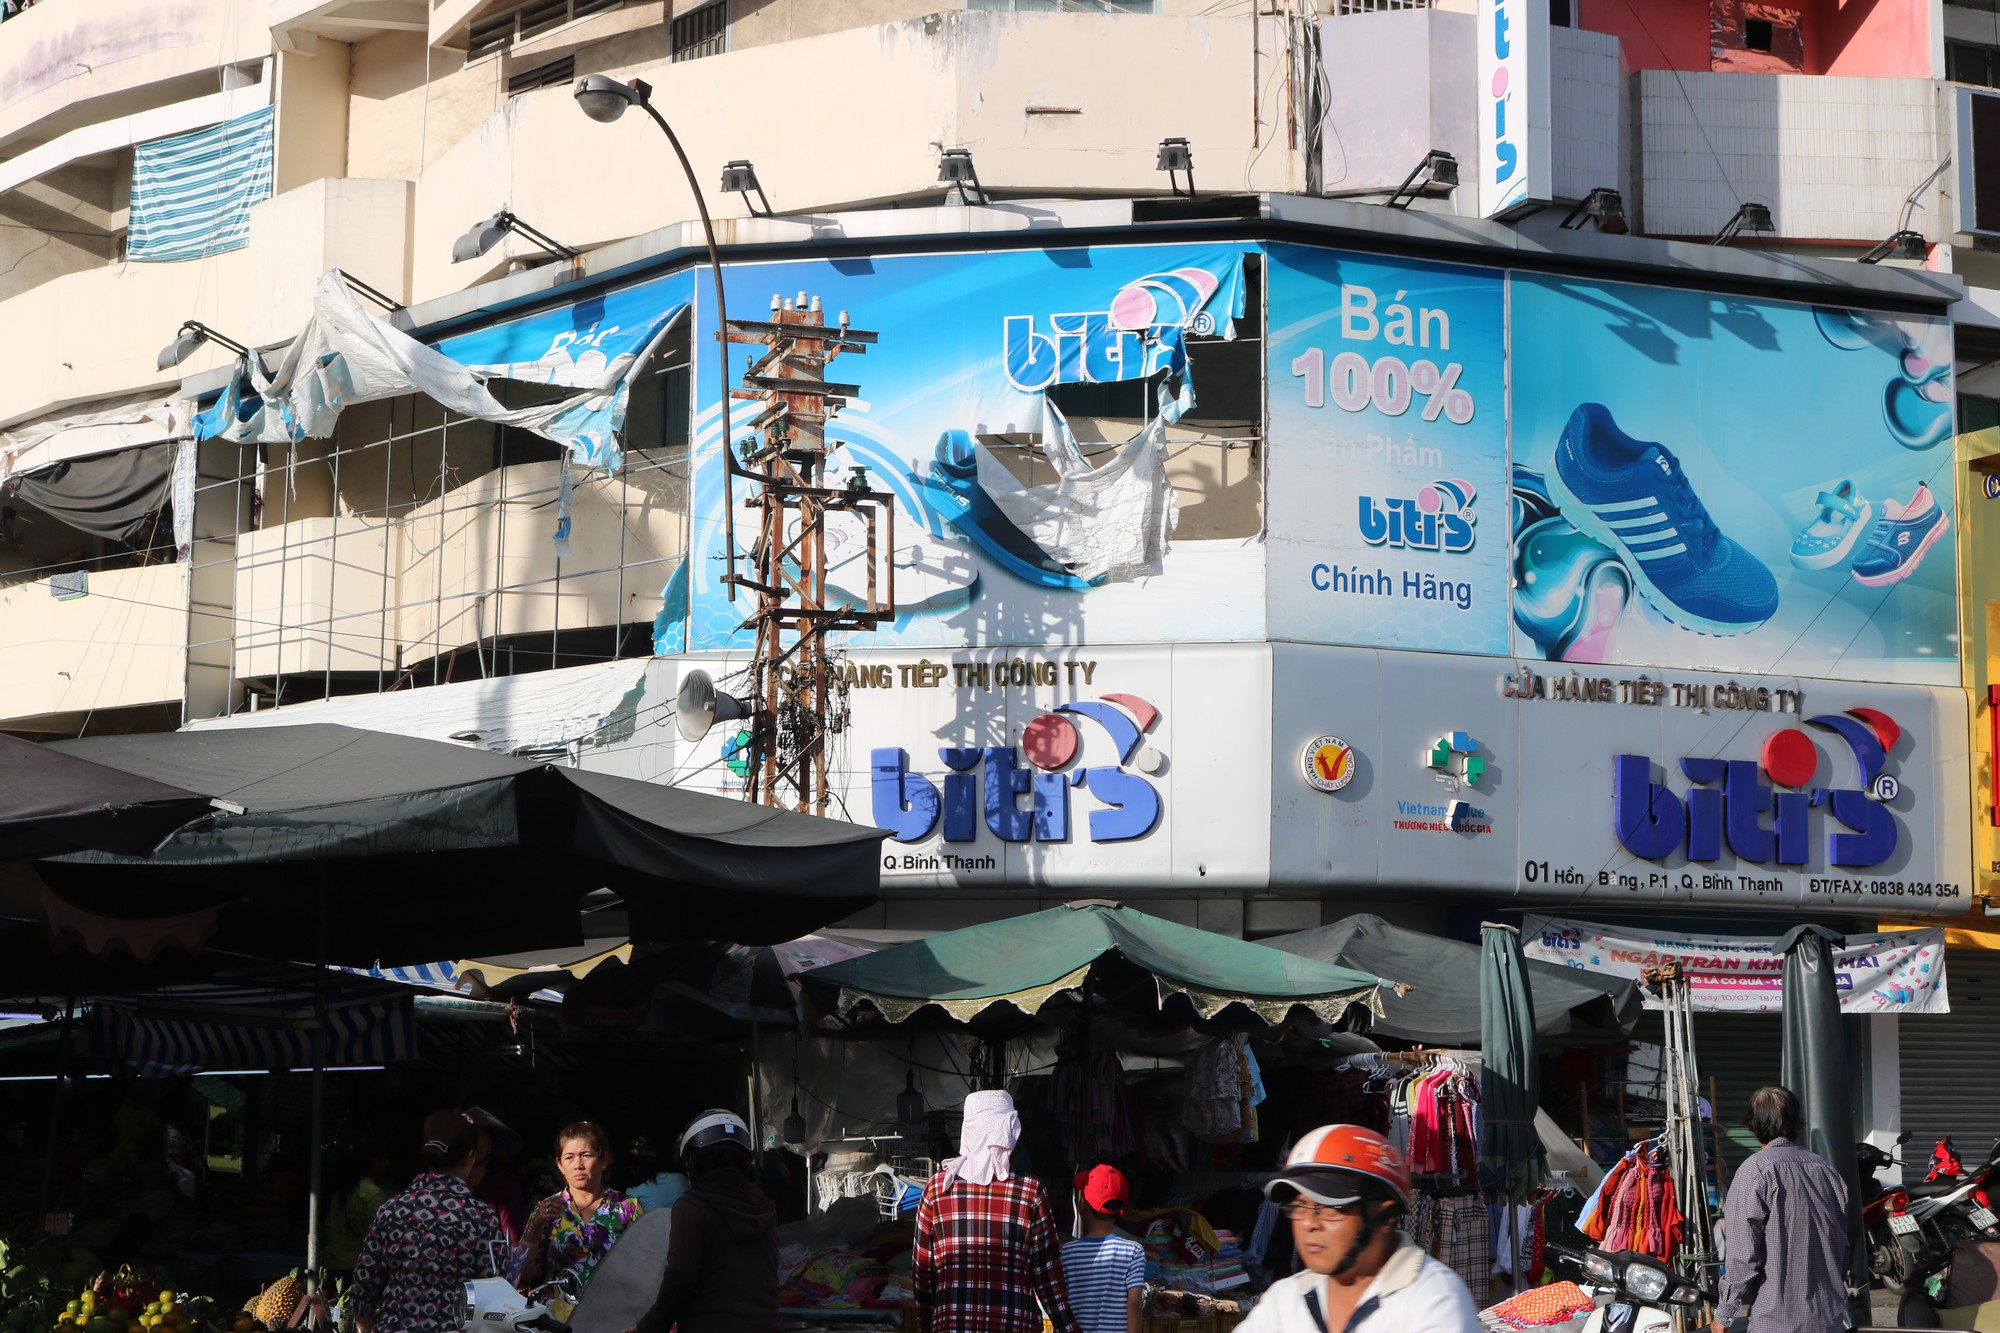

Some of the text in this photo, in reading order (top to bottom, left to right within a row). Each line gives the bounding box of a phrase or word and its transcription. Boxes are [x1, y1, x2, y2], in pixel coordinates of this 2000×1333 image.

[1491, 0, 1518, 185] ti's
[1341, 283, 1450, 351] Bán
[1292, 347, 1475, 424] 100%
[1358, 485, 1473, 550] biti's
[1311, 563, 1472, 610] Chính Hãng
[952, 663, 990, 691] THỊ
[994, 656, 1058, 686] CÔNG
[1063, 660, 1097, 685] TY
[1713, 680, 1769, 712] CÔNG
[1775, 689, 1802, 714] TY
[1325, 738, 1344, 748] NAM
[871, 713, 1160, 843] biti's
[1614, 728, 1898, 867] biti's
[1477, 824, 1492, 833] GIA
[903, 852, 939, 869] Bình
[943, 855, 996, 872] Thạnh
[1525, 860, 1549, 883] 01
[1702, 874, 1733, 890] Bình
[1738, 877, 1783, 895] Thạnh
[1871, 881, 1904, 894] 0838
[1908, 882, 1932, 897] 434
[1935, 884, 1960, 897] 354
[1541, 928, 1581, 950] biti's
[1680, 955, 1741, 970] TRÀN
[1838, 953, 1880, 969] MÃI
[1704, 976, 1719, 985] LÀ
[1721, 977, 1738, 986] CÓ
[1739, 978, 1764, 986] QUÀ
